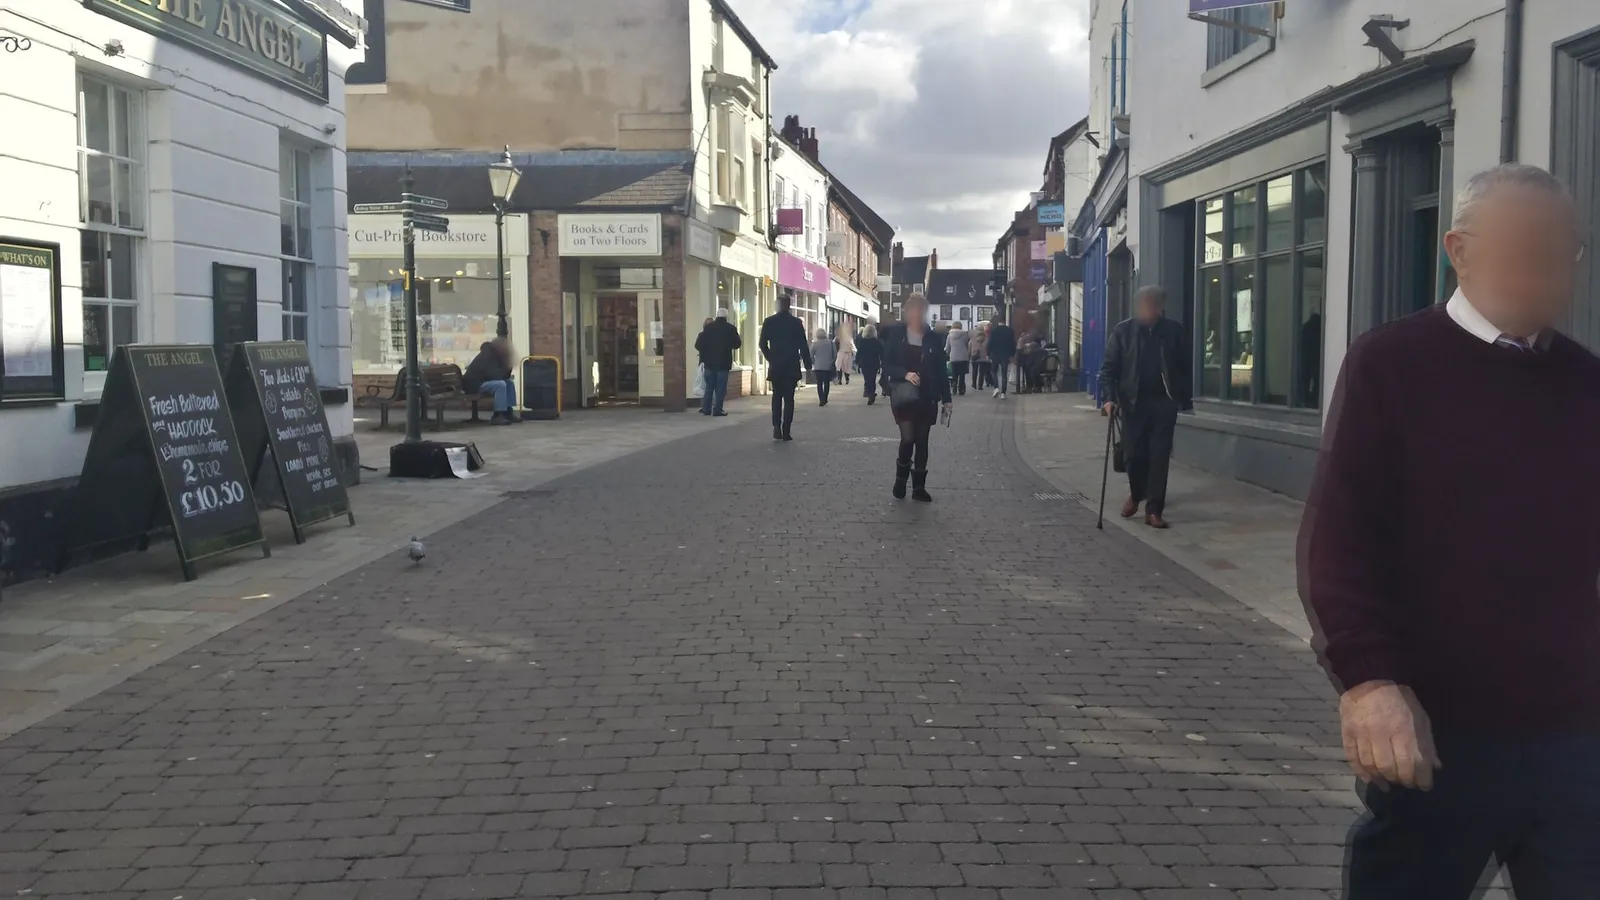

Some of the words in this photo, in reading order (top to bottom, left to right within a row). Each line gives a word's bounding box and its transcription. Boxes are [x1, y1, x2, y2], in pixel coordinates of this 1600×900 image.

[216, 0, 306, 74] ANGEL
[354, 229, 416, 242] Cut-Pri
[421, 229, 487, 242] Bookstore
[571, 224, 603, 234] Books
[606, 224, 616, 234] &
[619, 224, 649, 234] Cards
[573, 237, 586, 246] on
[589, 236, 611, 246] Two
[614, 235, 647, 246] Floors
[2, 252, 33, 265] WHAT'S
[33, 255, 47, 267] ON
[144, 353, 169, 367] THE
[170, 351, 204, 365] ANGEL
[257, 348, 275, 361] THE
[276, 347, 301, 360] ANGEL
[148, 394, 178, 416] Fresh
[179, 390, 220, 414] Battered
[167, 417, 217, 440] HADDOCK
[207, 437, 229, 456] chips
[182, 458, 198, 485] 2
[197, 459, 223, 480] FOR
[180, 480, 245, 517] £10.50
